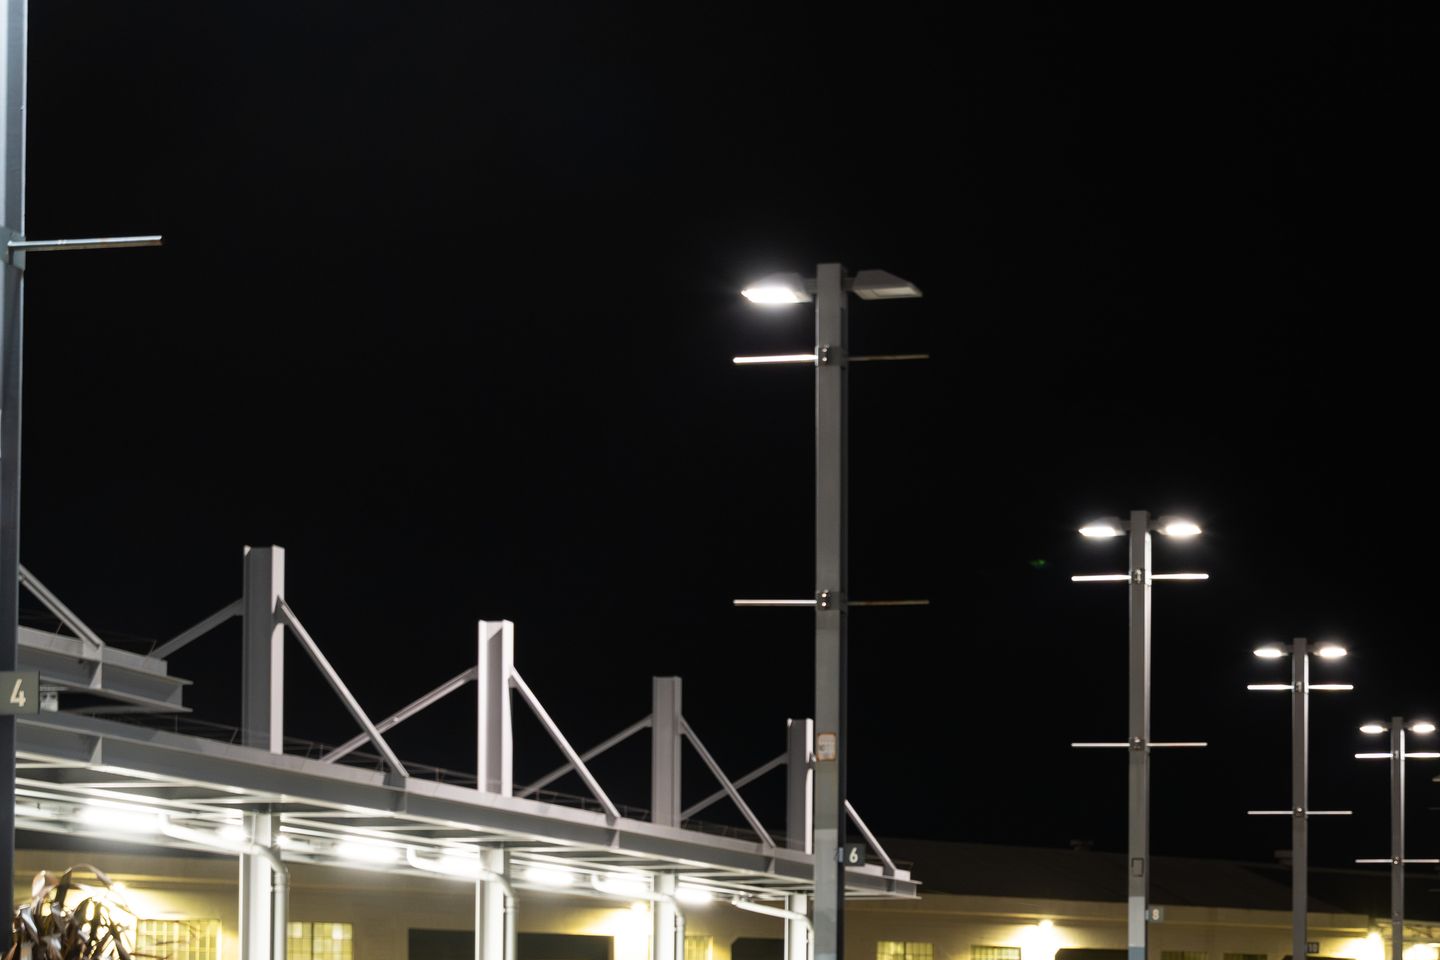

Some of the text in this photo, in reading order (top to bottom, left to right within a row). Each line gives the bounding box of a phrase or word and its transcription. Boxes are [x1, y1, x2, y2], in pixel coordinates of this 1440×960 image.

[10, 678, 26, 707] 4
[848, 847, 858, 863] 6
[1152, 908, 1159, 920] 8
